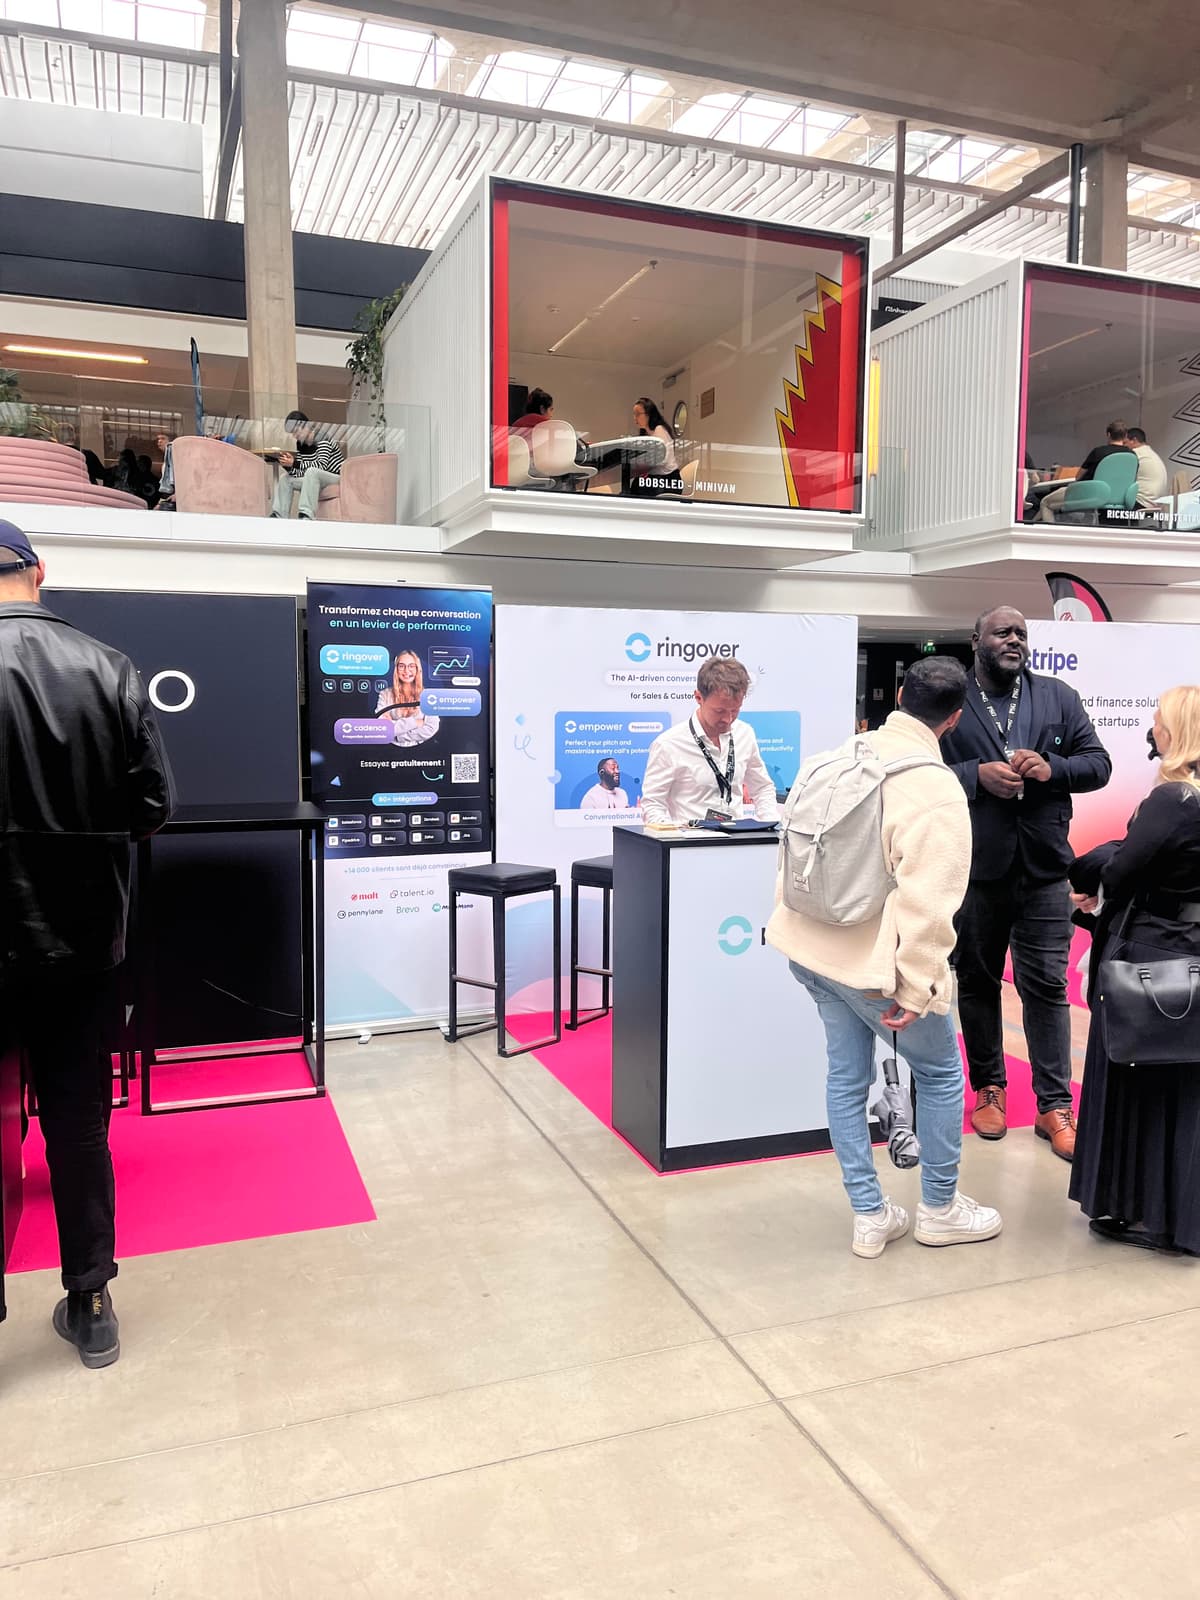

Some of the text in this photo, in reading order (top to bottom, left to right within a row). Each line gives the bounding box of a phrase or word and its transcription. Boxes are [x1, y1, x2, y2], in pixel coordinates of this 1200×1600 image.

[638, 478, 684, 489] BOBSLED
[695, 481, 736, 493] MINIVAN
[1107, 510, 1145, 520] RICKSHAW
[318, 605, 481, 620] Transformez chaque conversation
[329, 619, 472, 633] en un levier de performance
[656, 636, 740, 663] ringover
[342, 652, 384, 663] ringover
[611, 674, 697, 683] The AI-driven convers
[439, 696, 476, 705] empower
[630, 692, 641, 700] for
[642, 692, 662, 700] Sales
[1081, 696, 1159, 708] nd finance solut
[578, 722, 623, 733] empower
[1098, 716, 1140, 729] startups
[354, 724, 387, 732] cadence
[602, 740, 619, 748] pitch
[596, 749, 613, 757] every
[630, 748, 650, 757] poten
[360, 760, 390, 769] Essayez
[390, 760, 442, 769] gratuitement
[584, 812, 636, 821] Conversational
[372, 864, 394, 873] clients
[358, 889, 434, 901] malt talent.io
[348, 908, 384, 918] pennylane
[396, 906, 420, 914] Brevo
